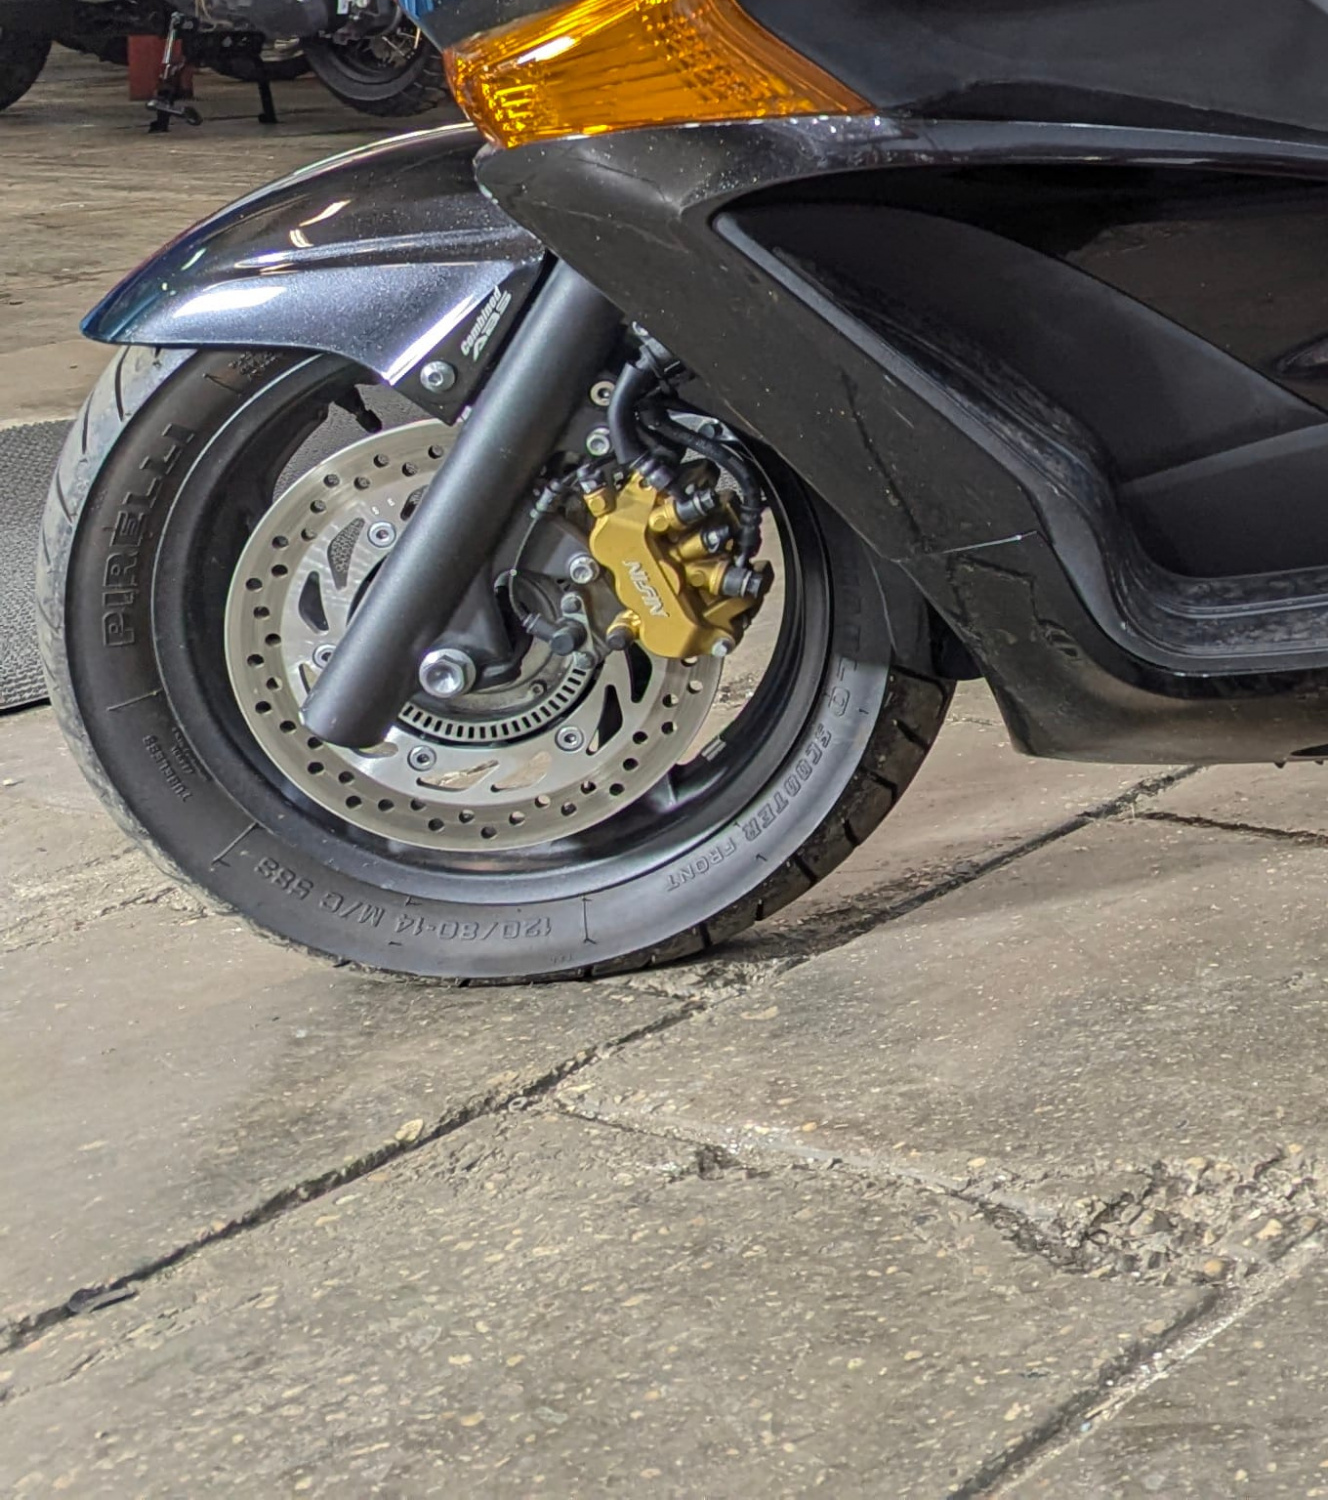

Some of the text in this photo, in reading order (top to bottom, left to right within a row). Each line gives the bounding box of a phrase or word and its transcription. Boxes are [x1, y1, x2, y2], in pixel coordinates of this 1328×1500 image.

[461, 285, 502, 357] Combined
[473, 290, 512, 362] ABS
[102, 422, 196, 647] PIRELLI
[664, 837, 738, 893] FRONT
